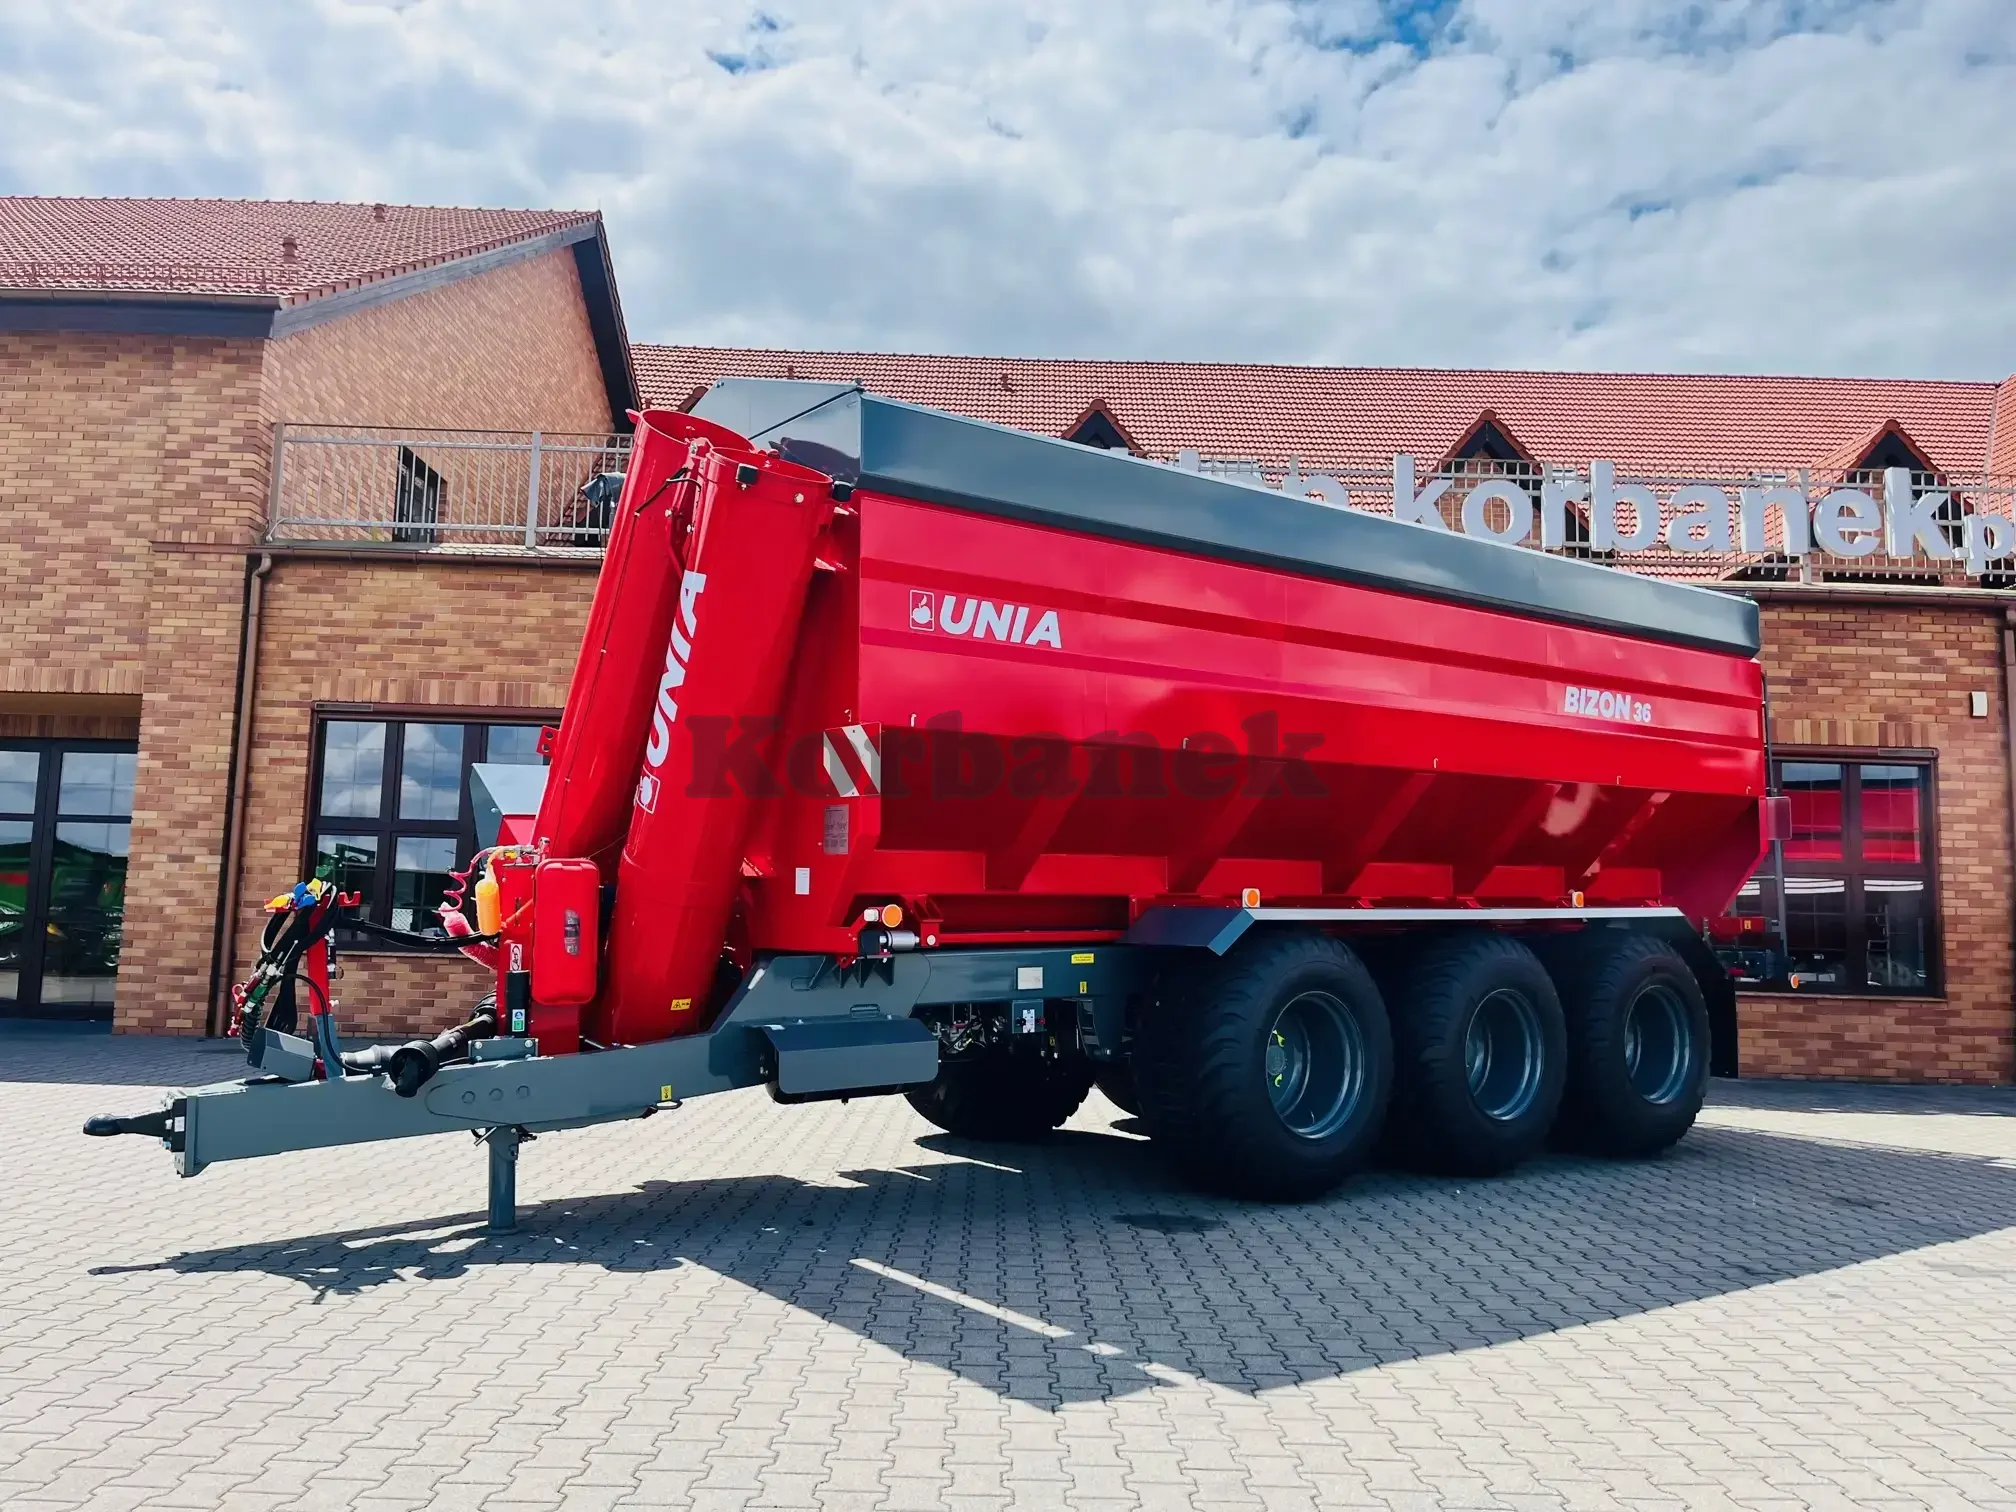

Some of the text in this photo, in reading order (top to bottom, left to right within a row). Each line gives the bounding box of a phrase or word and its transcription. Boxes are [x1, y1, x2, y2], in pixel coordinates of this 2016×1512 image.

[1393, 454, 2016, 575] korbanek.p
[940, 595, 1062, 648] UNIA
[646, 570, 706, 767] UNIA
[1564, 686, 1651, 722] BIZON 36
